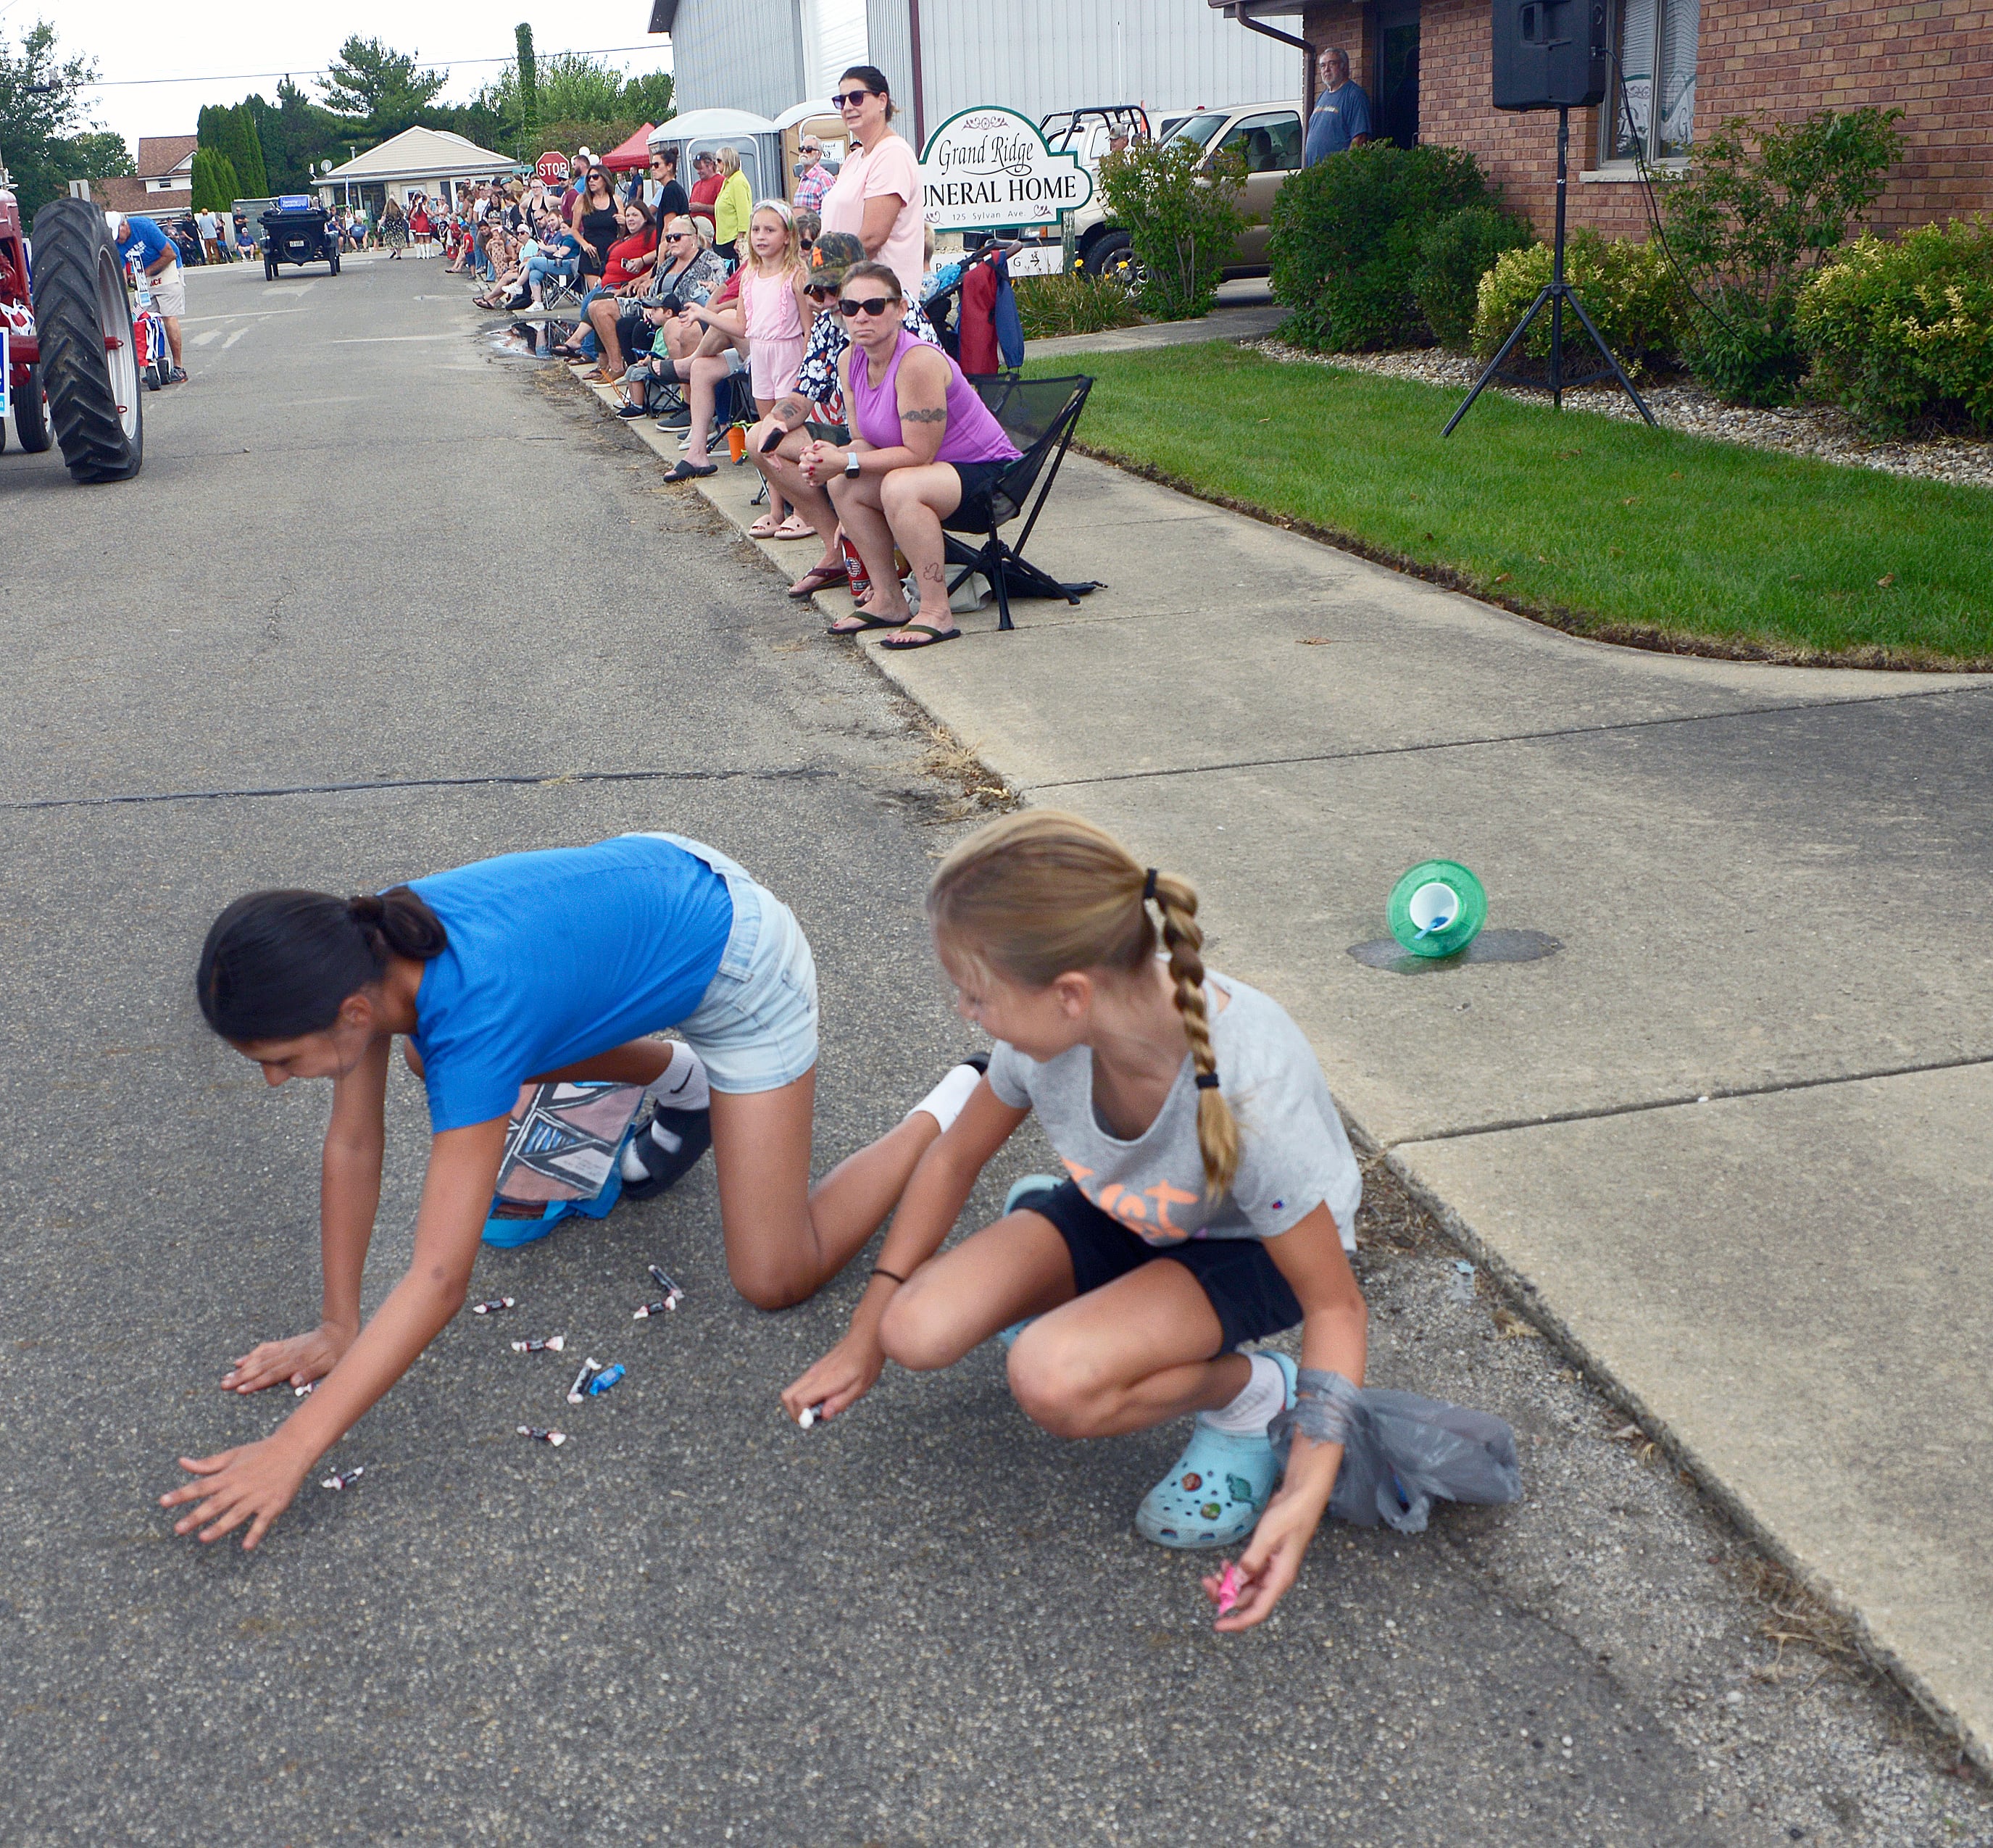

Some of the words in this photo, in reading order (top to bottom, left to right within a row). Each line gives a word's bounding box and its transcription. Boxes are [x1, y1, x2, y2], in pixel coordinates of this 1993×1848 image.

[939, 135, 989, 175] Grand
[991, 133, 1033, 176] Ridge
[538, 162, 567, 176] STOP
[923, 181, 1002, 207] UNERAL
[1009, 176, 1076, 201] HOME
[973, 212, 1001, 220] Sylvan
